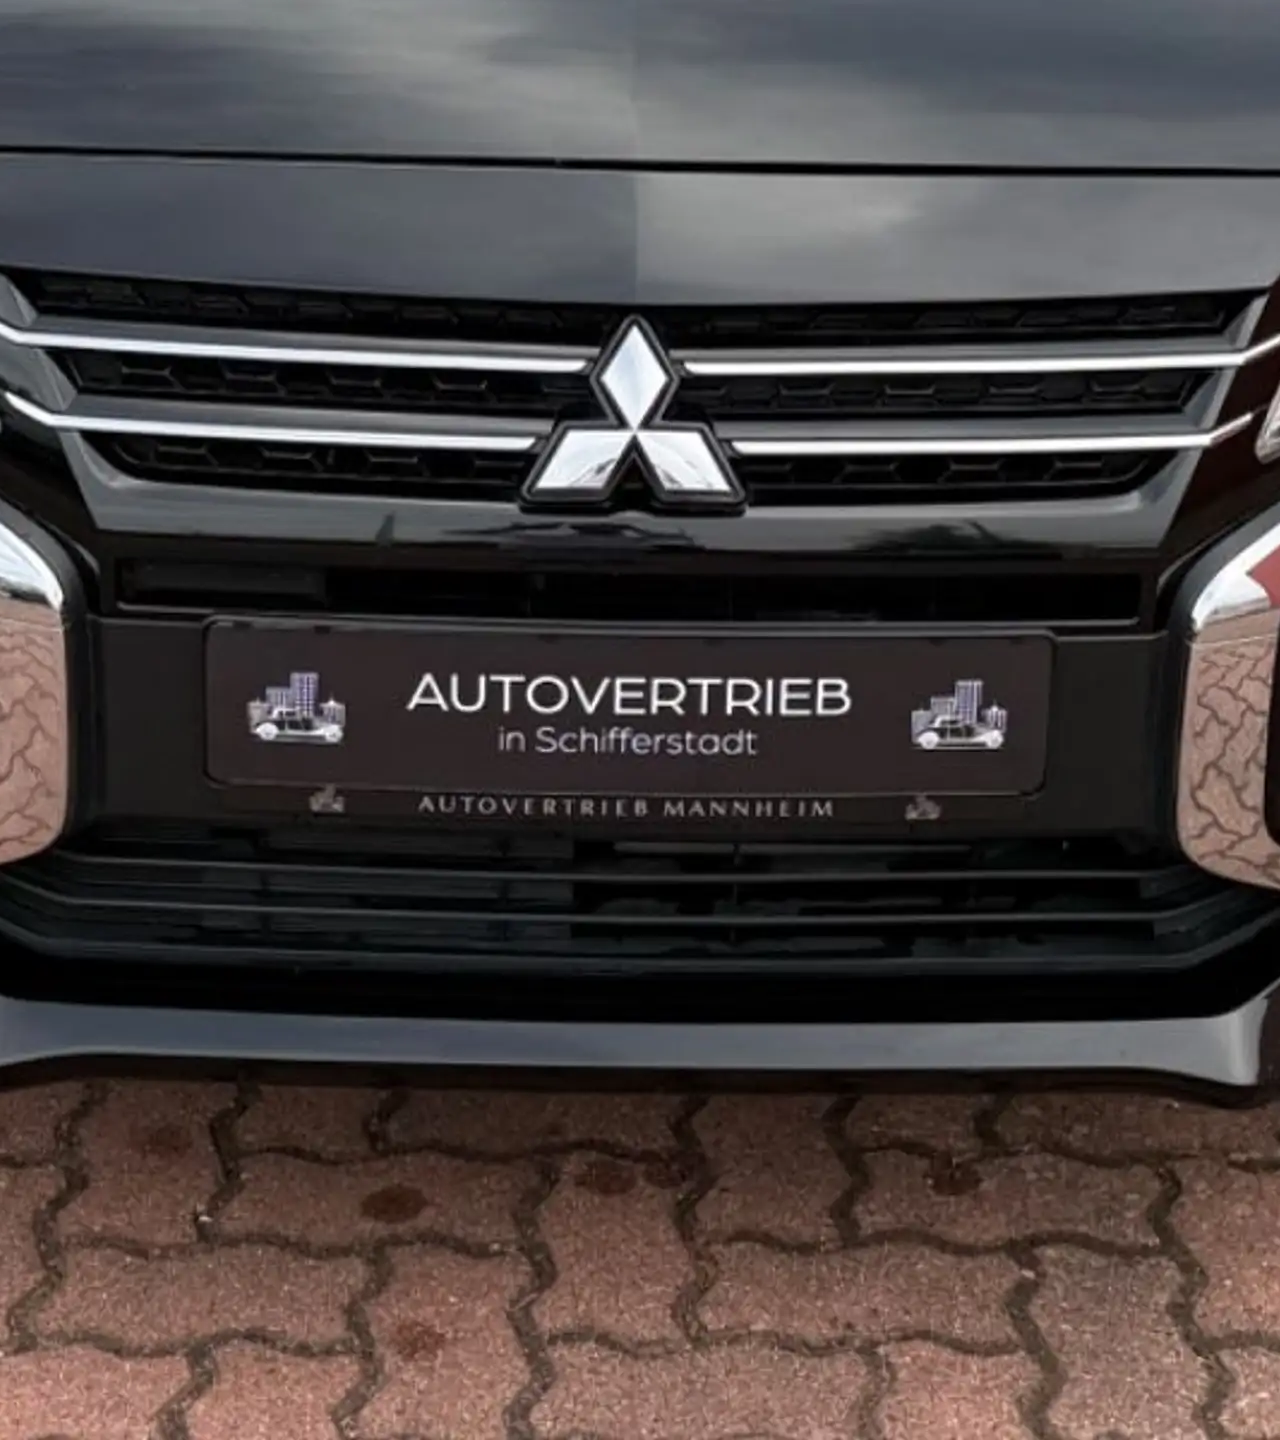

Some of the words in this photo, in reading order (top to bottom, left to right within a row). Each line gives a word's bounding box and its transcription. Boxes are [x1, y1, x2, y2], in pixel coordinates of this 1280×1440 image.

[406, 672, 852, 717] AUTOVERTRIEB
[498, 726, 526, 753] in
[534, 726, 759, 757] Schifferstadt
[417, 794, 650, 817] AUTOVERTRIEB
[662, 798, 835, 819] MANNHEIM
